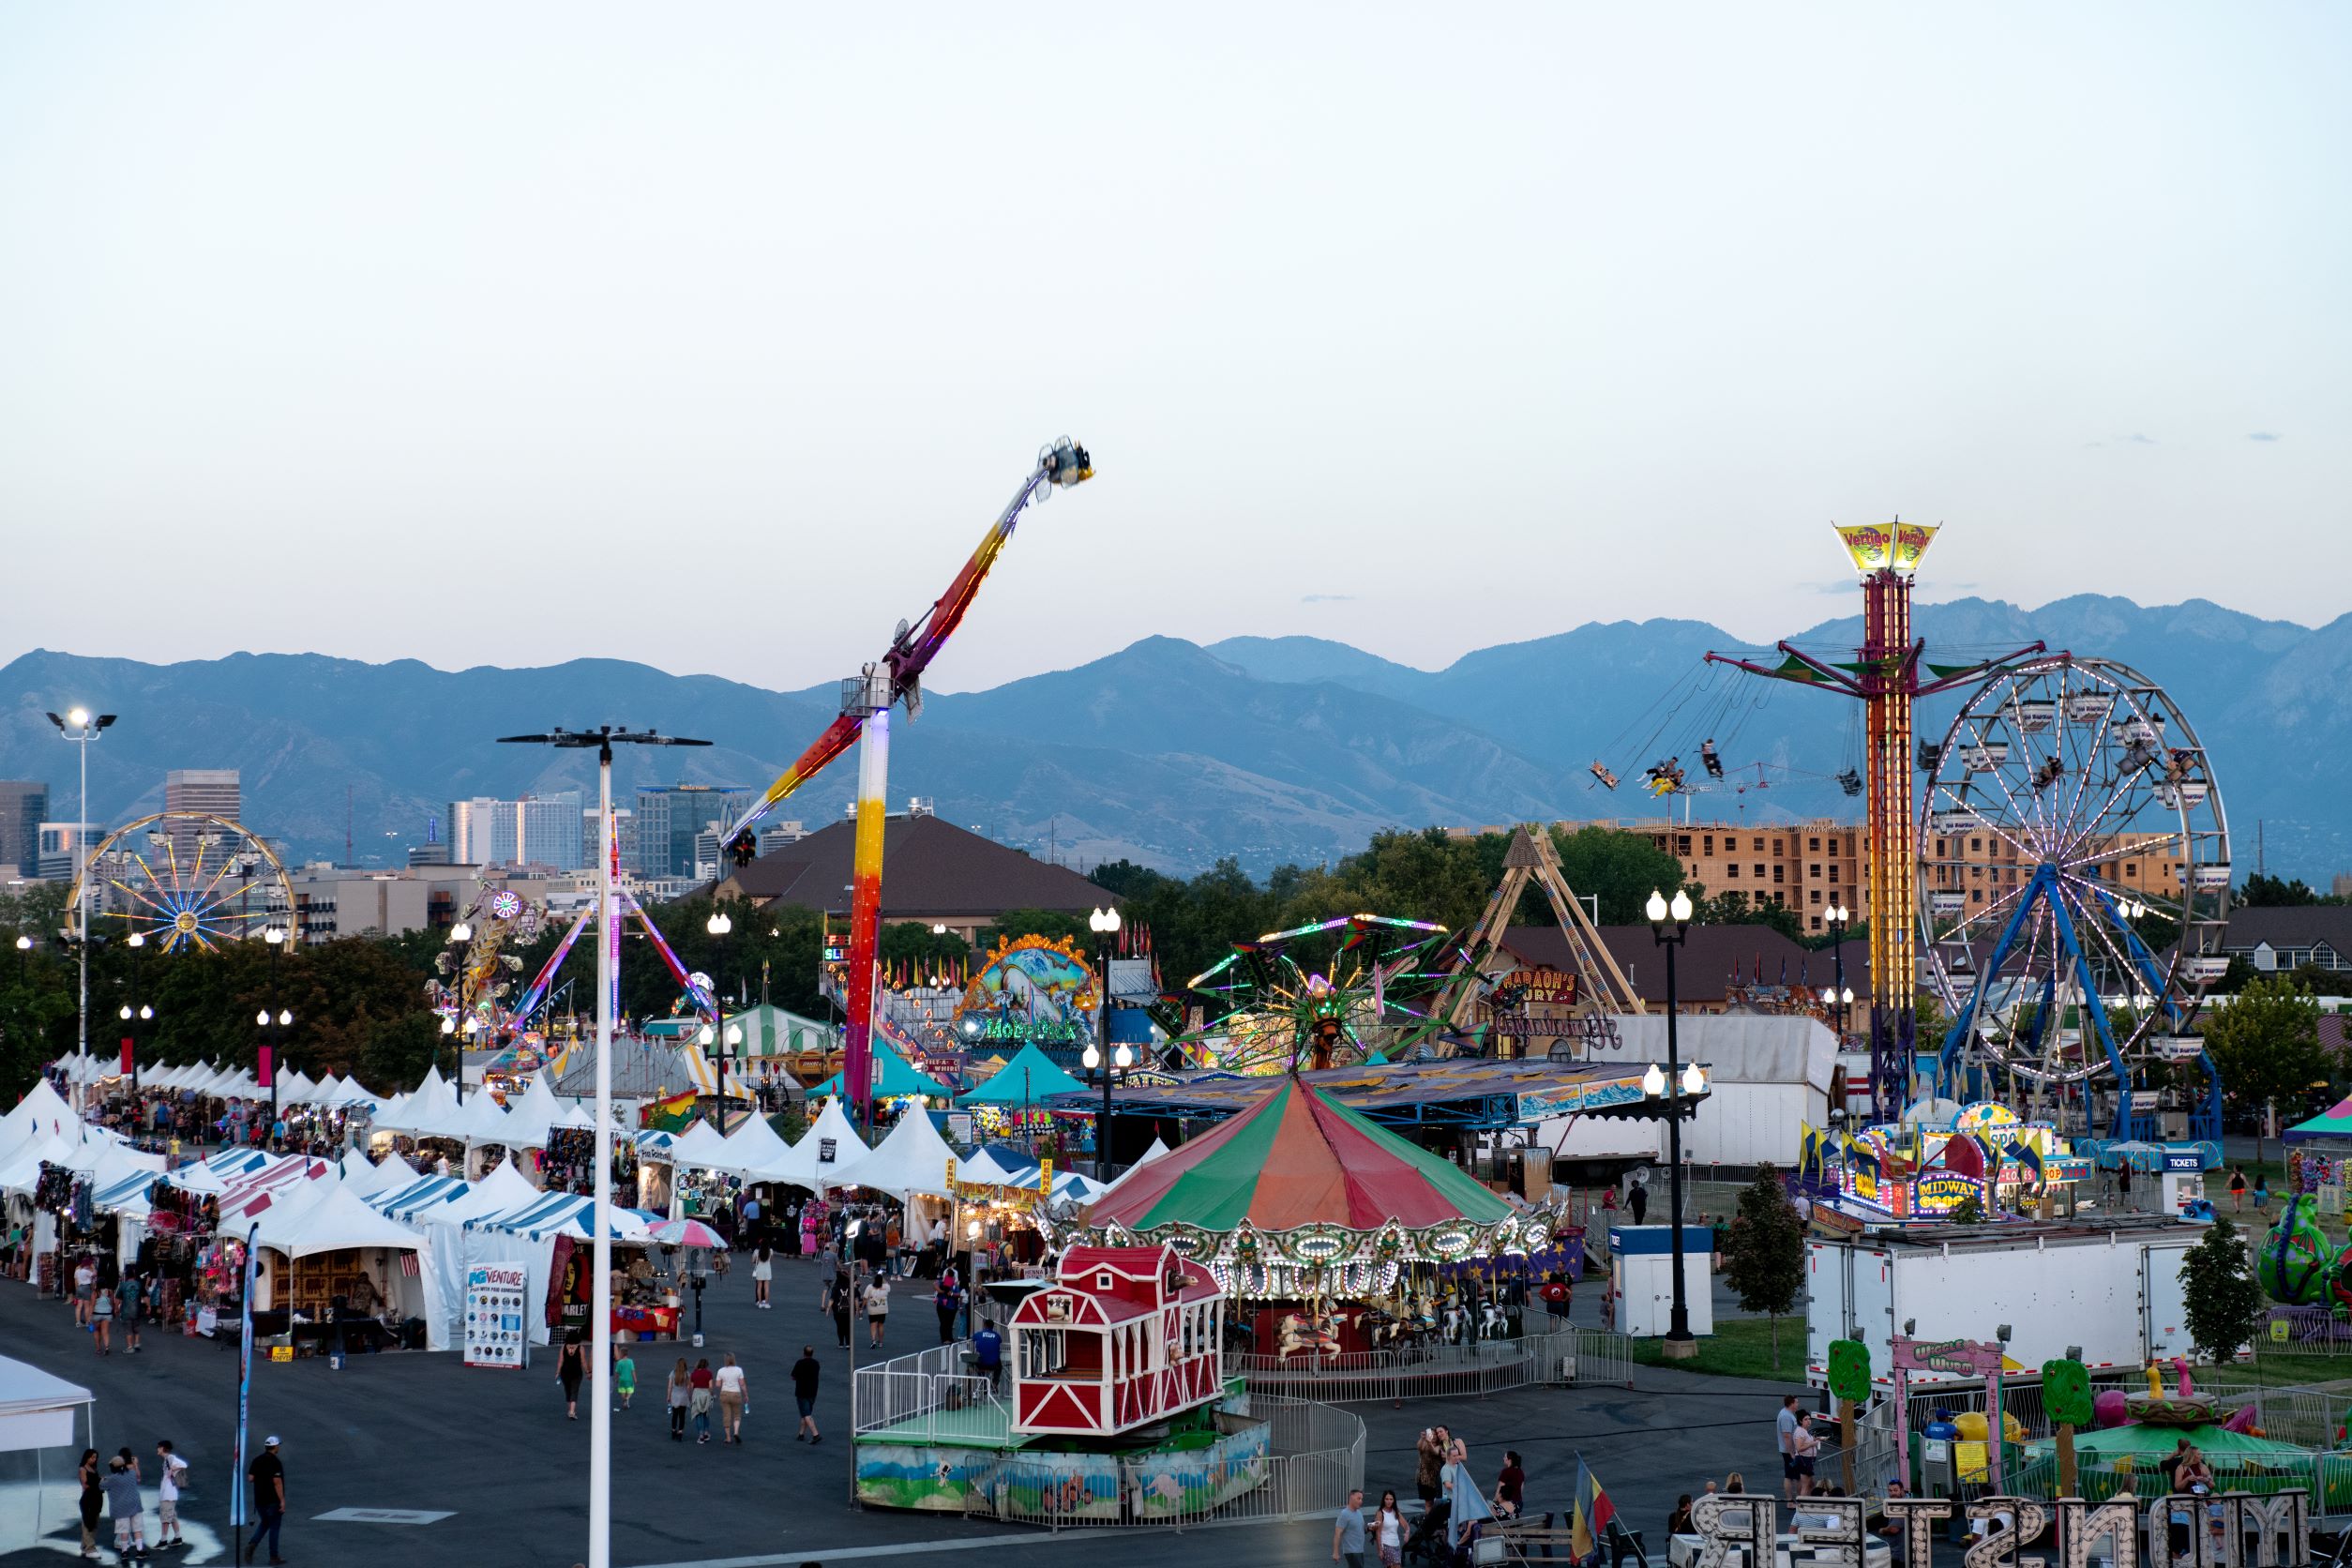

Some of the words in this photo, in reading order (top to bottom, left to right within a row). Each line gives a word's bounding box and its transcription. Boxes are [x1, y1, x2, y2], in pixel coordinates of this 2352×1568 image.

[1844, 529, 1891, 549] Vertigo
[1898, 529, 1930, 550] Vertigo
[1503, 972, 1575, 991] HARAOH'S
[1522, 988, 1557, 1002] URY
[987, 1018, 1033, 1043] Moby
[1036, 1018, 1077, 1040] Dick
[2169, 1158, 2198, 1168] TICKETS
[1919, 1181, 1979, 1197] MIDWAY
[1894, 1186, 1903, 1214] GRILL
